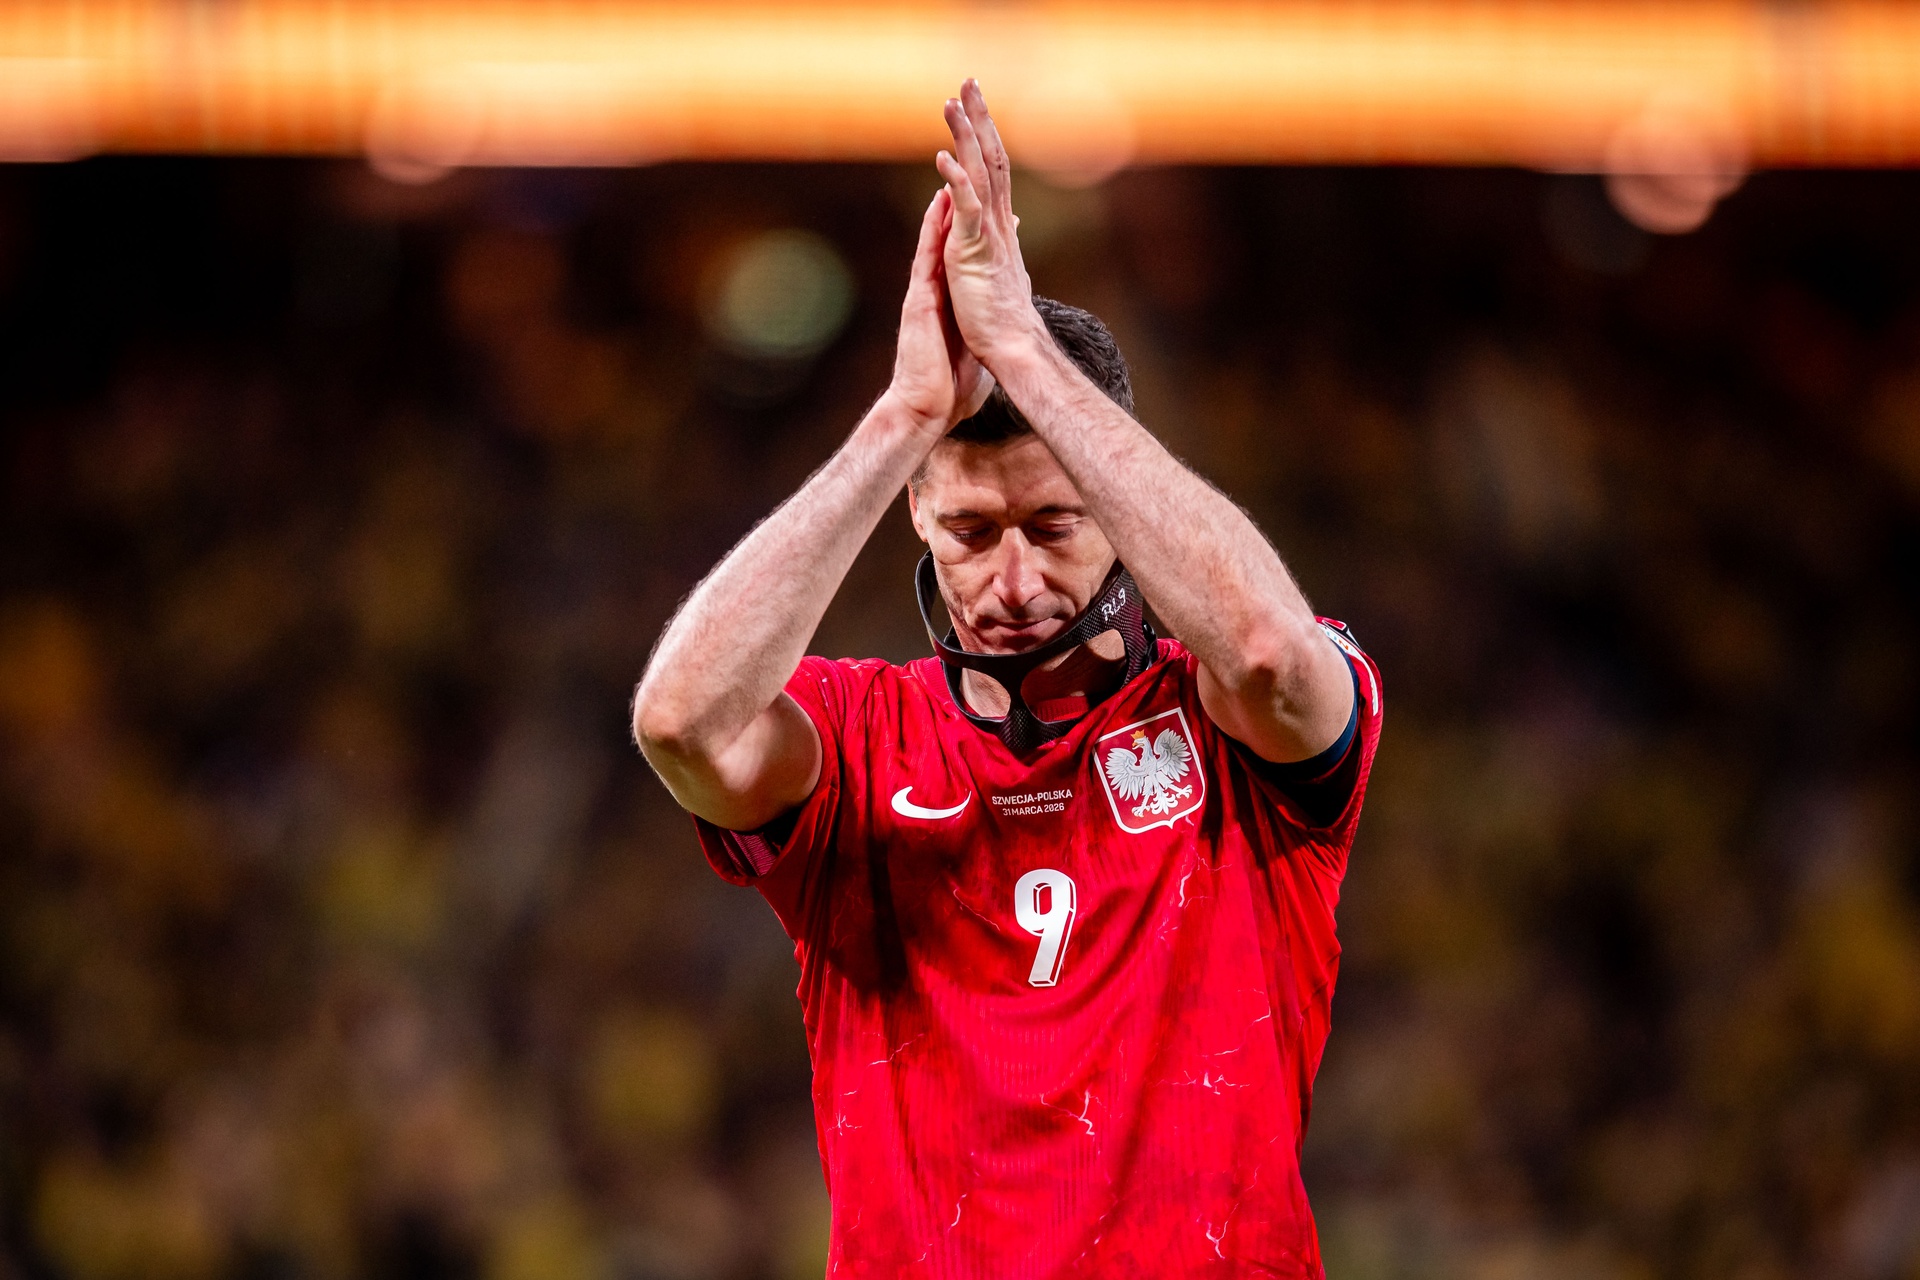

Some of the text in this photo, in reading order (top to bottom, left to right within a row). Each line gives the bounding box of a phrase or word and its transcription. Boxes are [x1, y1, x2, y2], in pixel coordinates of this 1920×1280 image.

[1101, 587, 1126, 622] RL9
[991, 788, 1073, 805] SZWECJA-POLSKA
[1002, 802, 1065, 816] 31 MARCA 2026
[1014, 868, 1077, 987] 9
